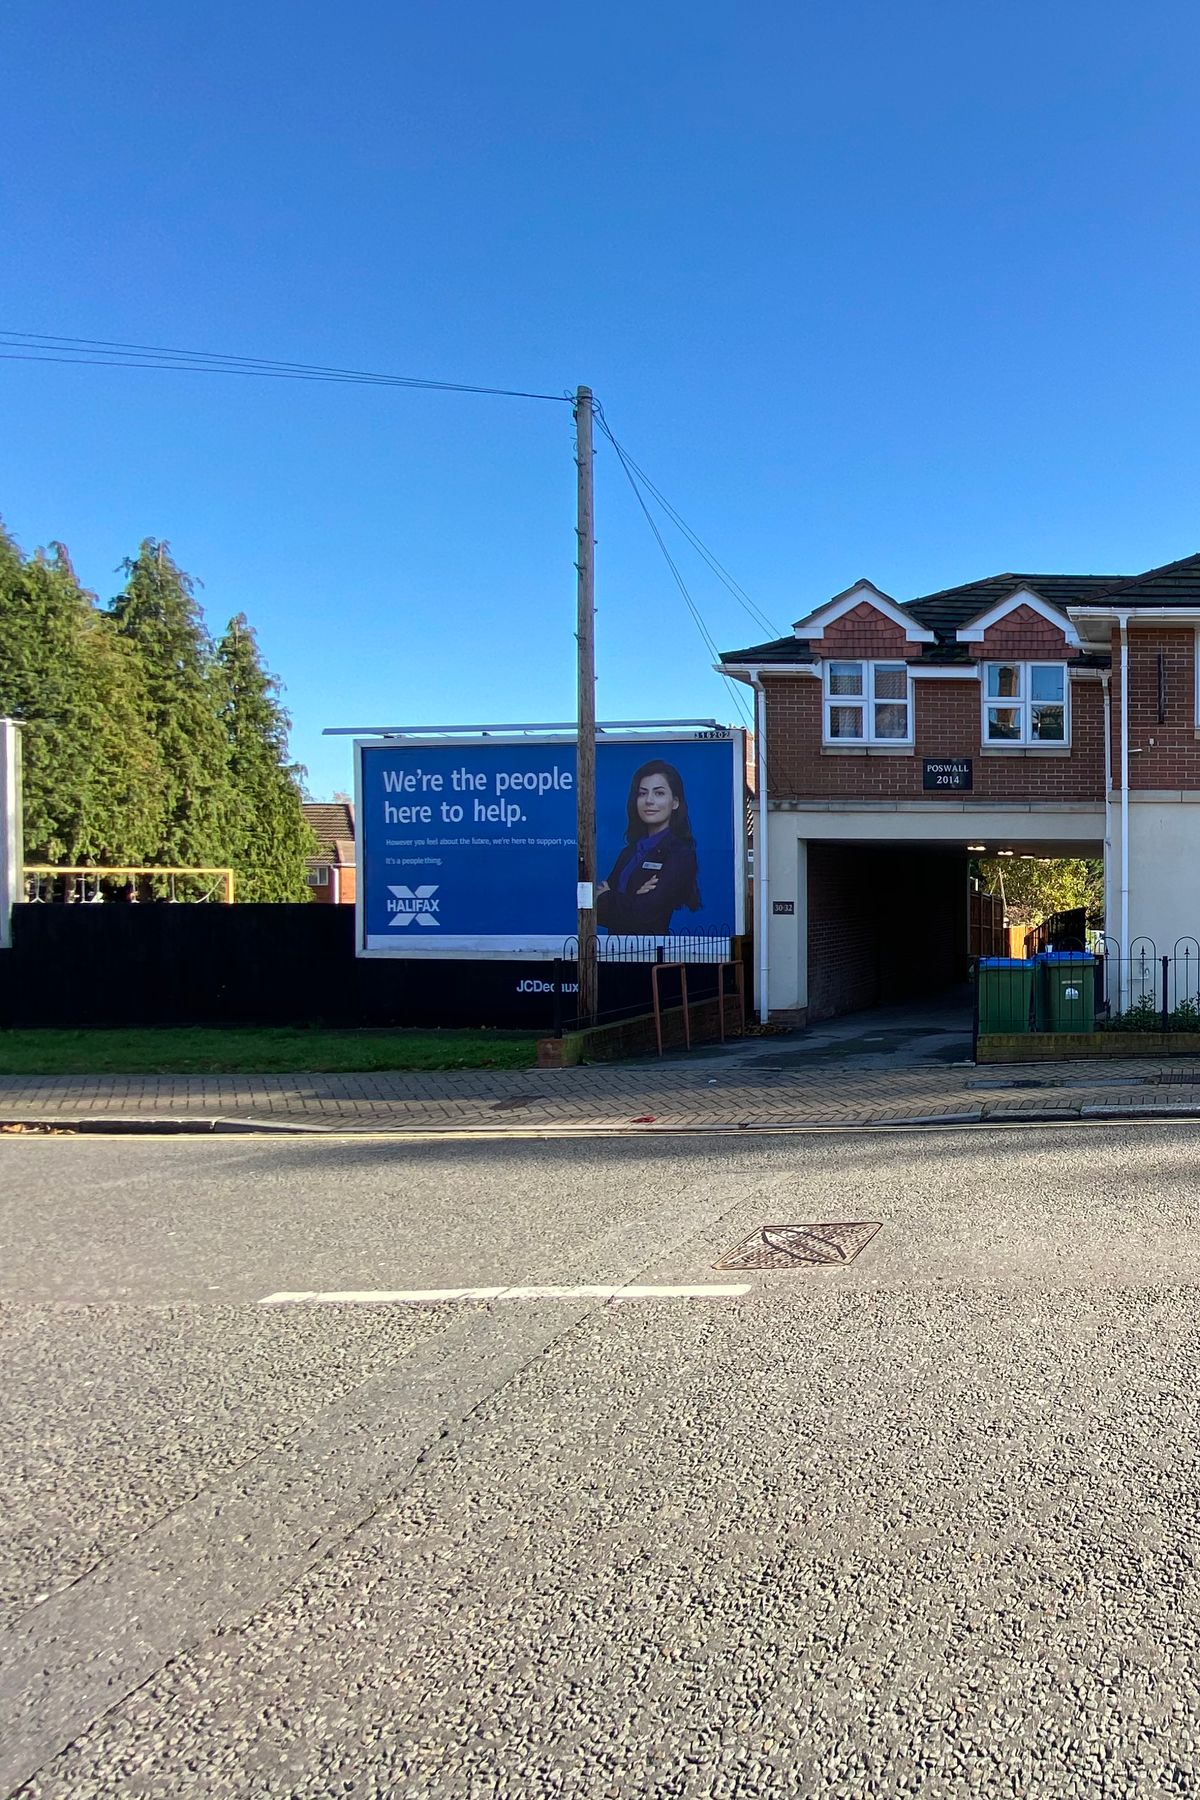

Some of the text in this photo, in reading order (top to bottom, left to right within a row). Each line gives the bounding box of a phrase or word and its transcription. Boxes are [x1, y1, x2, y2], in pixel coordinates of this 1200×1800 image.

[927, 764, 969, 772] POSWALL
[383, 766, 573, 796] We're the people
[936, 775, 960, 784] 2014
[385, 798, 527, 827] here to help.
[460, 837, 471, 845] the
[492, 837, 510, 845] we're
[527, 837, 535, 845] to
[536, 838, 562, 847] support
[385, 857, 396, 865] It's
[402, 857, 424, 866] people
[387, 900, 440, 912] HALIFAX
